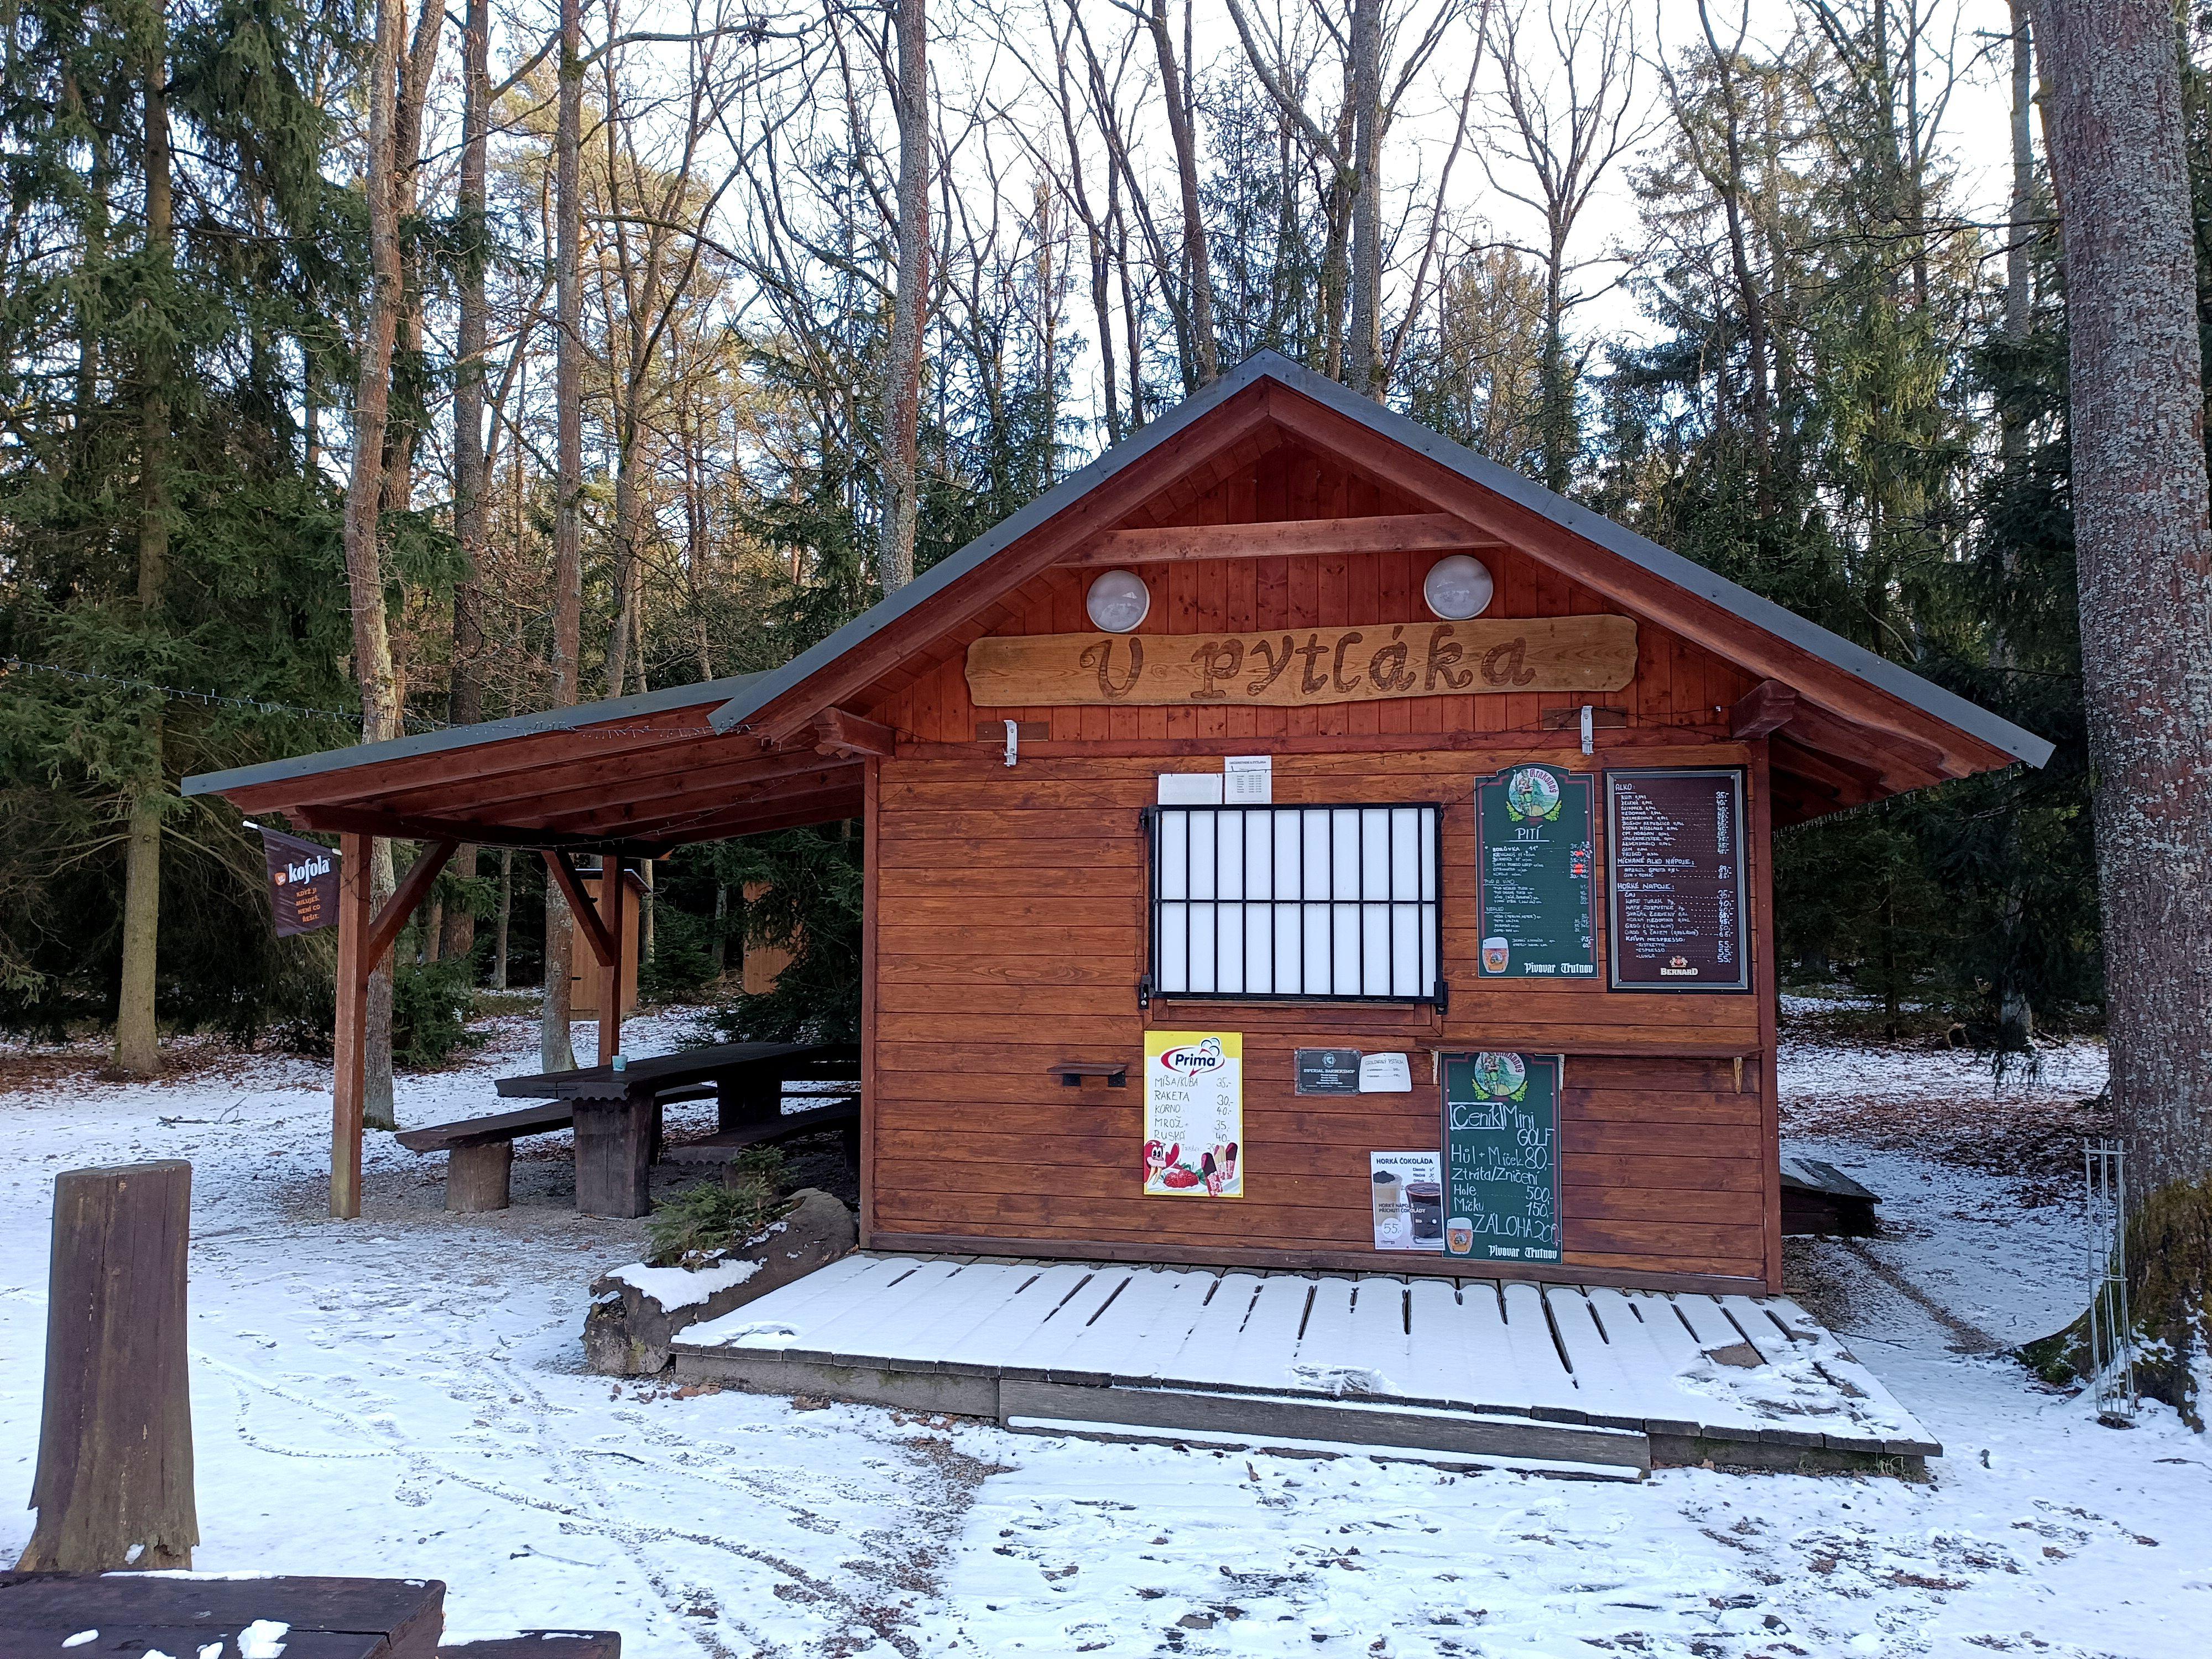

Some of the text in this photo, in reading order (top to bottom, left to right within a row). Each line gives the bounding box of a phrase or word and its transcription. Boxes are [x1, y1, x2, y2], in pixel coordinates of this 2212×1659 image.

[1079, 625, 1537, 699] U pytláka
[1515, 825, 1543, 840] PITÍ
[1617, 856, 1645, 864] MÍCHANÉ
[288, 855, 330, 885] kofola
[1524, 962, 1593, 973] Pivovar Trutnov
[1175, 1054, 1215, 1067] Prima
[1216, 1077, 1232, 1088] 35,-
[1154, 1090, 1233, 1107] RAKETA 30,-
[1155, 1104, 1181, 1114] KORNO
[1453, 1104, 1535, 1129] Ceník Mini
[1155, 1116, 1183, 1128] MROŽ
[1517, 1128, 1554, 1146] GOLF
[1451, 1144, 1476, 1165] Hůl
[1525, 1146, 1554, 1171] 80,-
[1451, 1166, 1540, 1185] Ztráta/Zničení
[1454, 1183, 1554, 1205] Hole 500,-
[1454, 1197, 1554, 1218] Míčku 150,-
[1473, 1213, 1532, 1238] ZÁLOHA
[1488, 1245, 1557, 1259] Pivovar Trutnov
